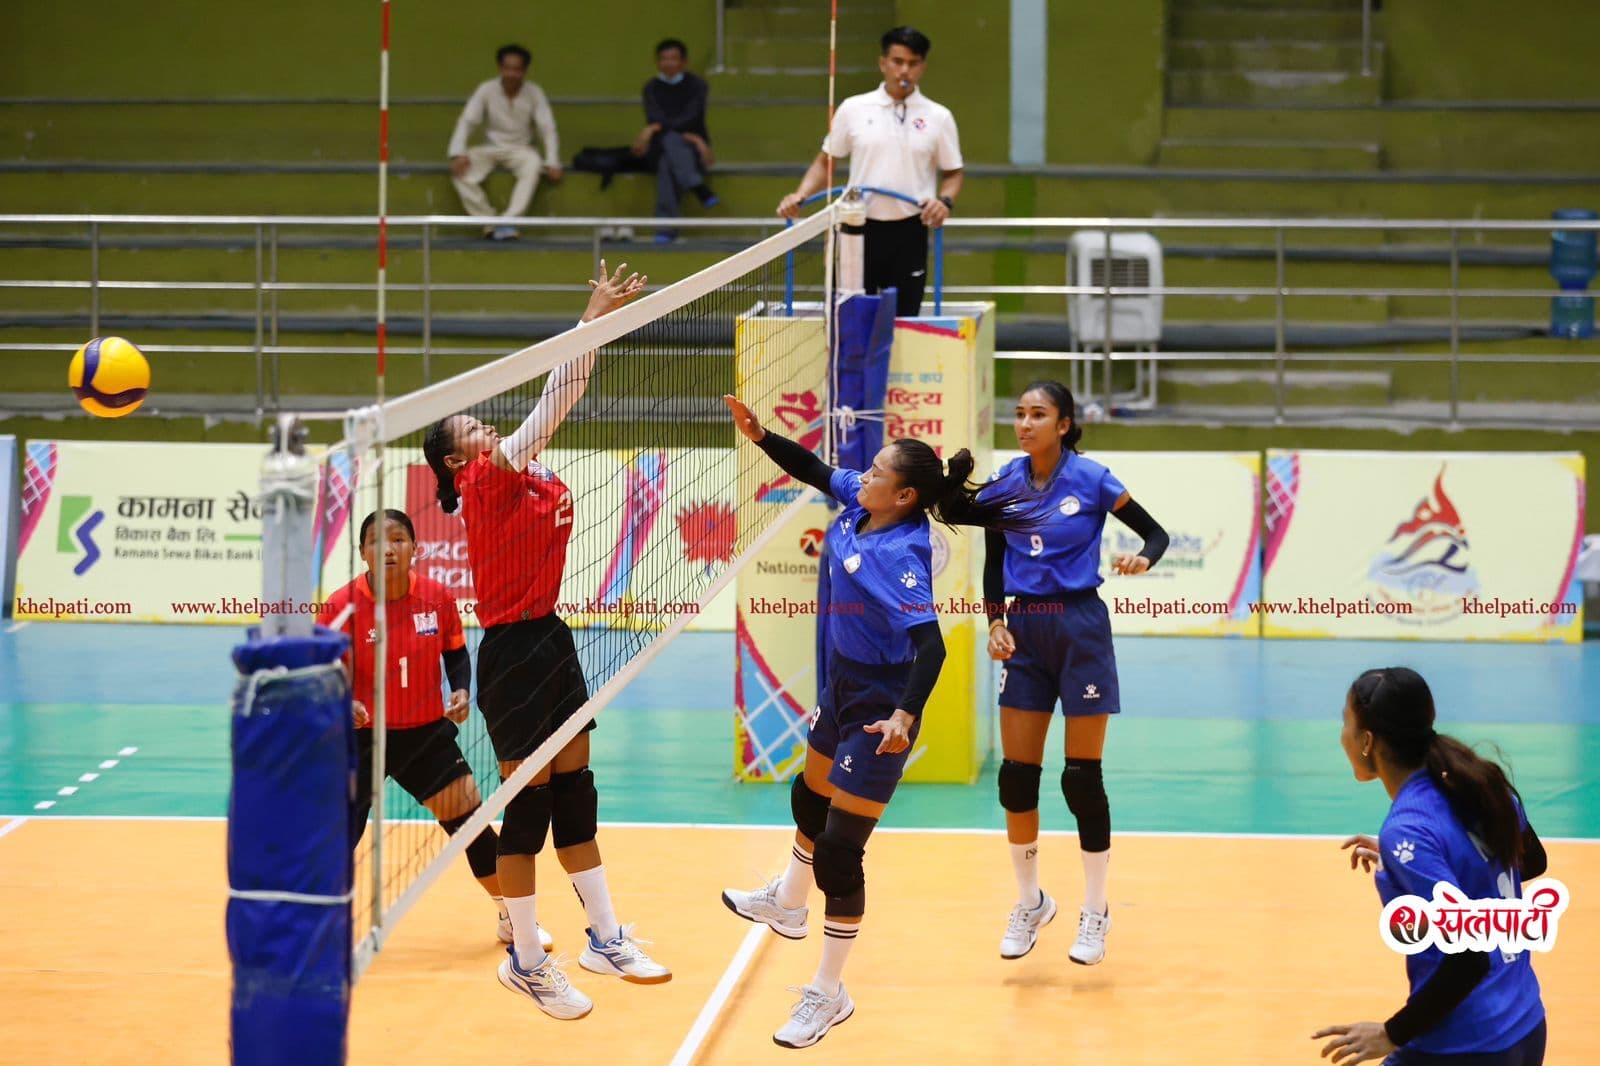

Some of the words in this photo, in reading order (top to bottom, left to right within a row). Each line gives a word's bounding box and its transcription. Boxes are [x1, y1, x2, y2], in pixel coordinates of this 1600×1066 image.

[117, 496, 216, 519] कामना
[1029, 534, 1045, 557] 9
[756, 560, 818, 577] Nationa
[399, 656, 408, 688] 1
